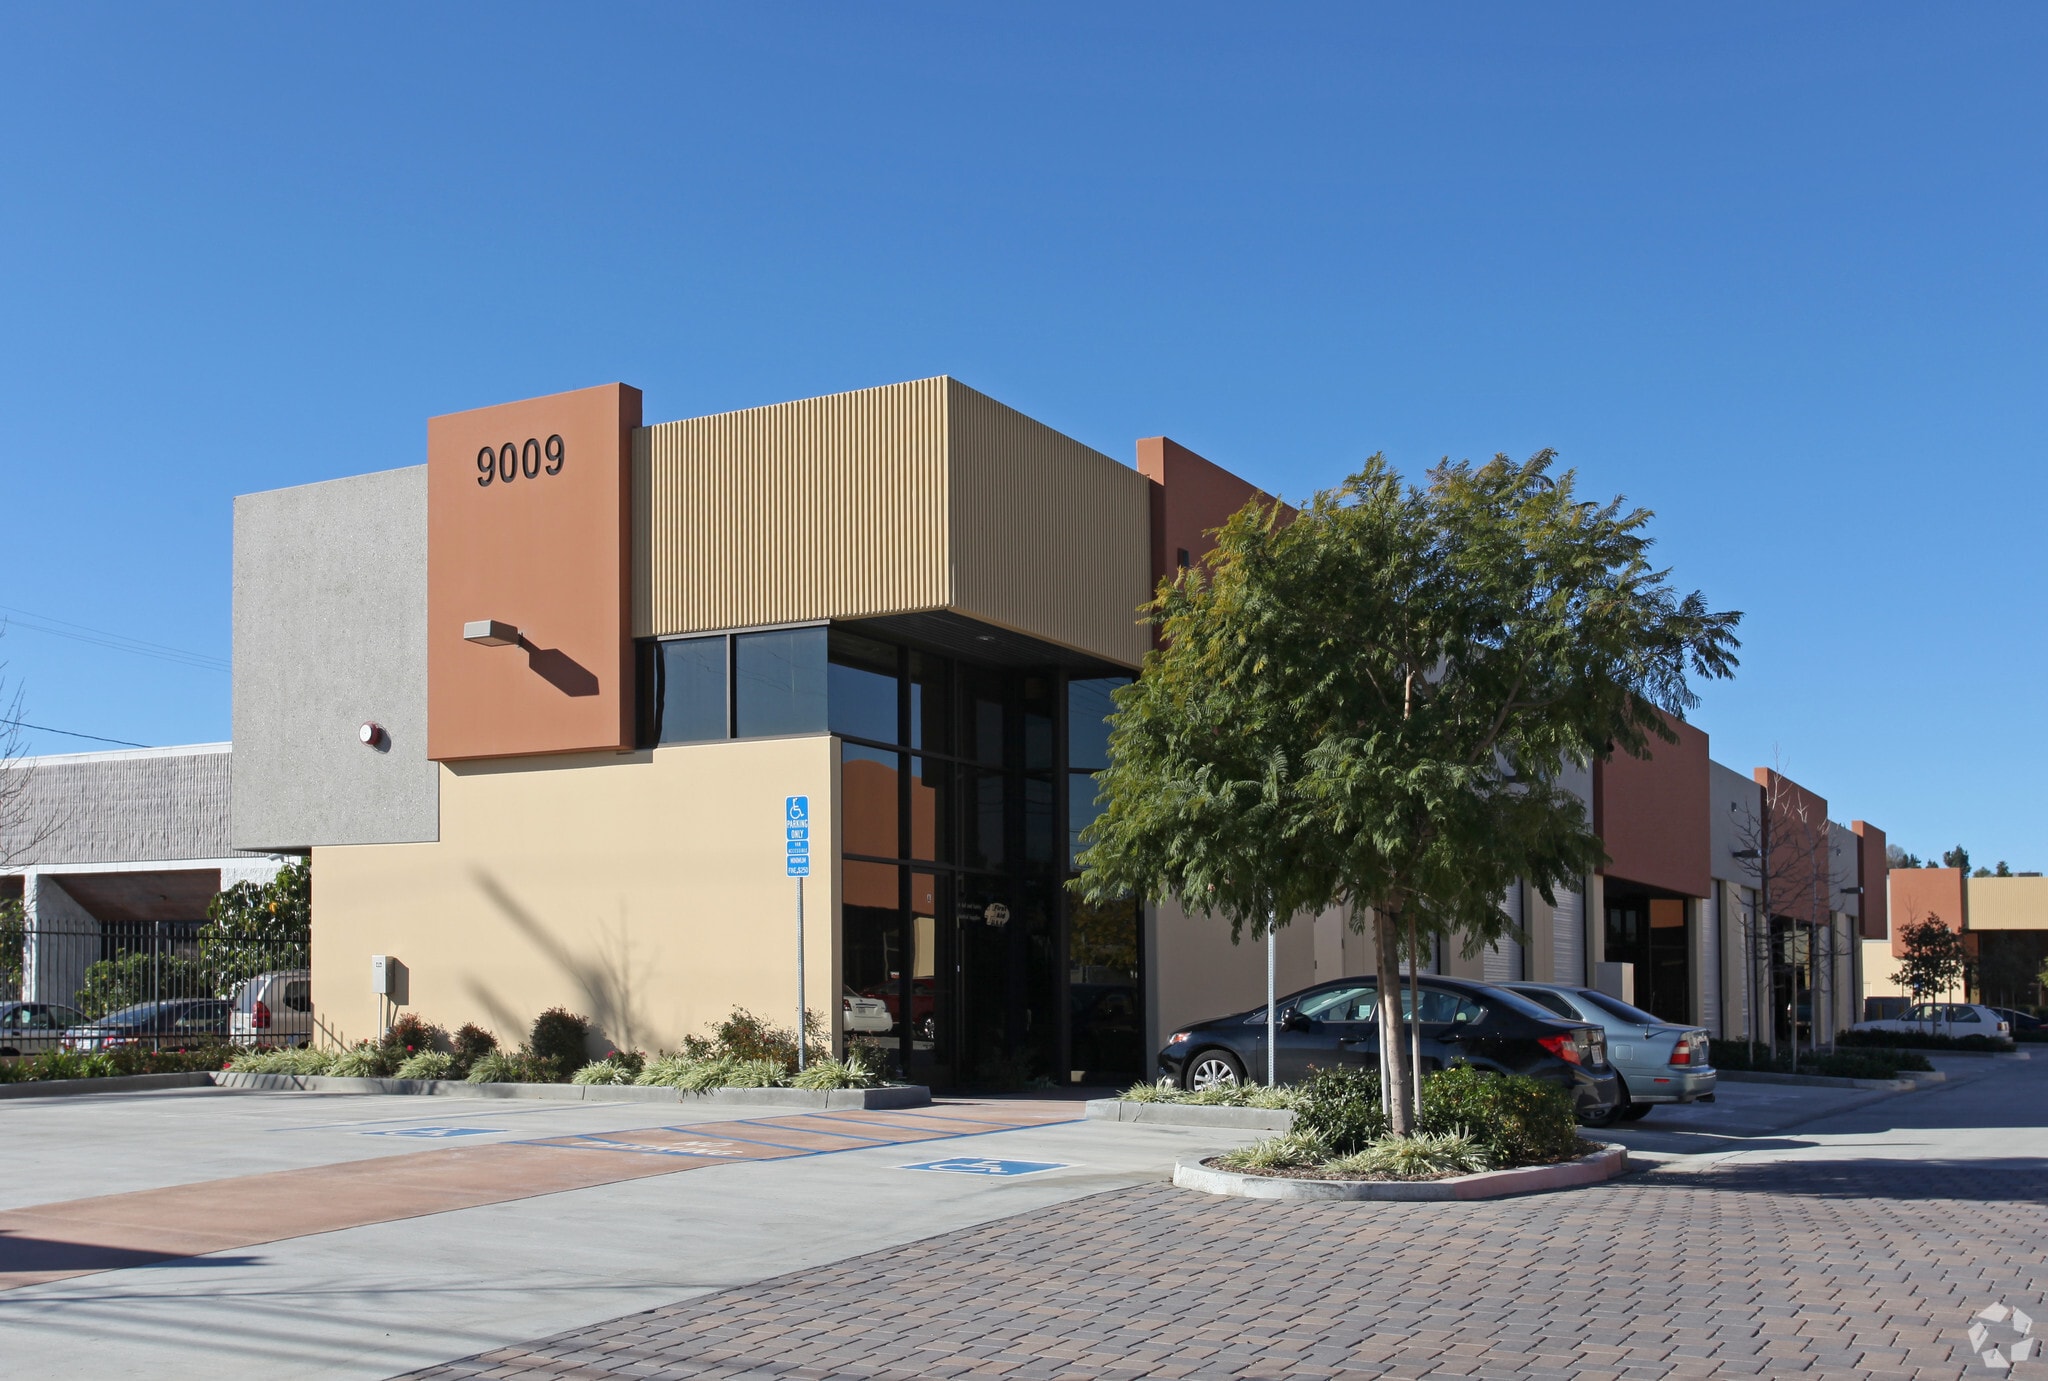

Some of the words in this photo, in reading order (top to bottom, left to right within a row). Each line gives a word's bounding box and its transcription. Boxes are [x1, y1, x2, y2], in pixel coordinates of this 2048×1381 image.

[477, 433, 565, 487] 9009
[787, 819, 808, 828] PARKING
[791, 829, 804, 838] ONLY
